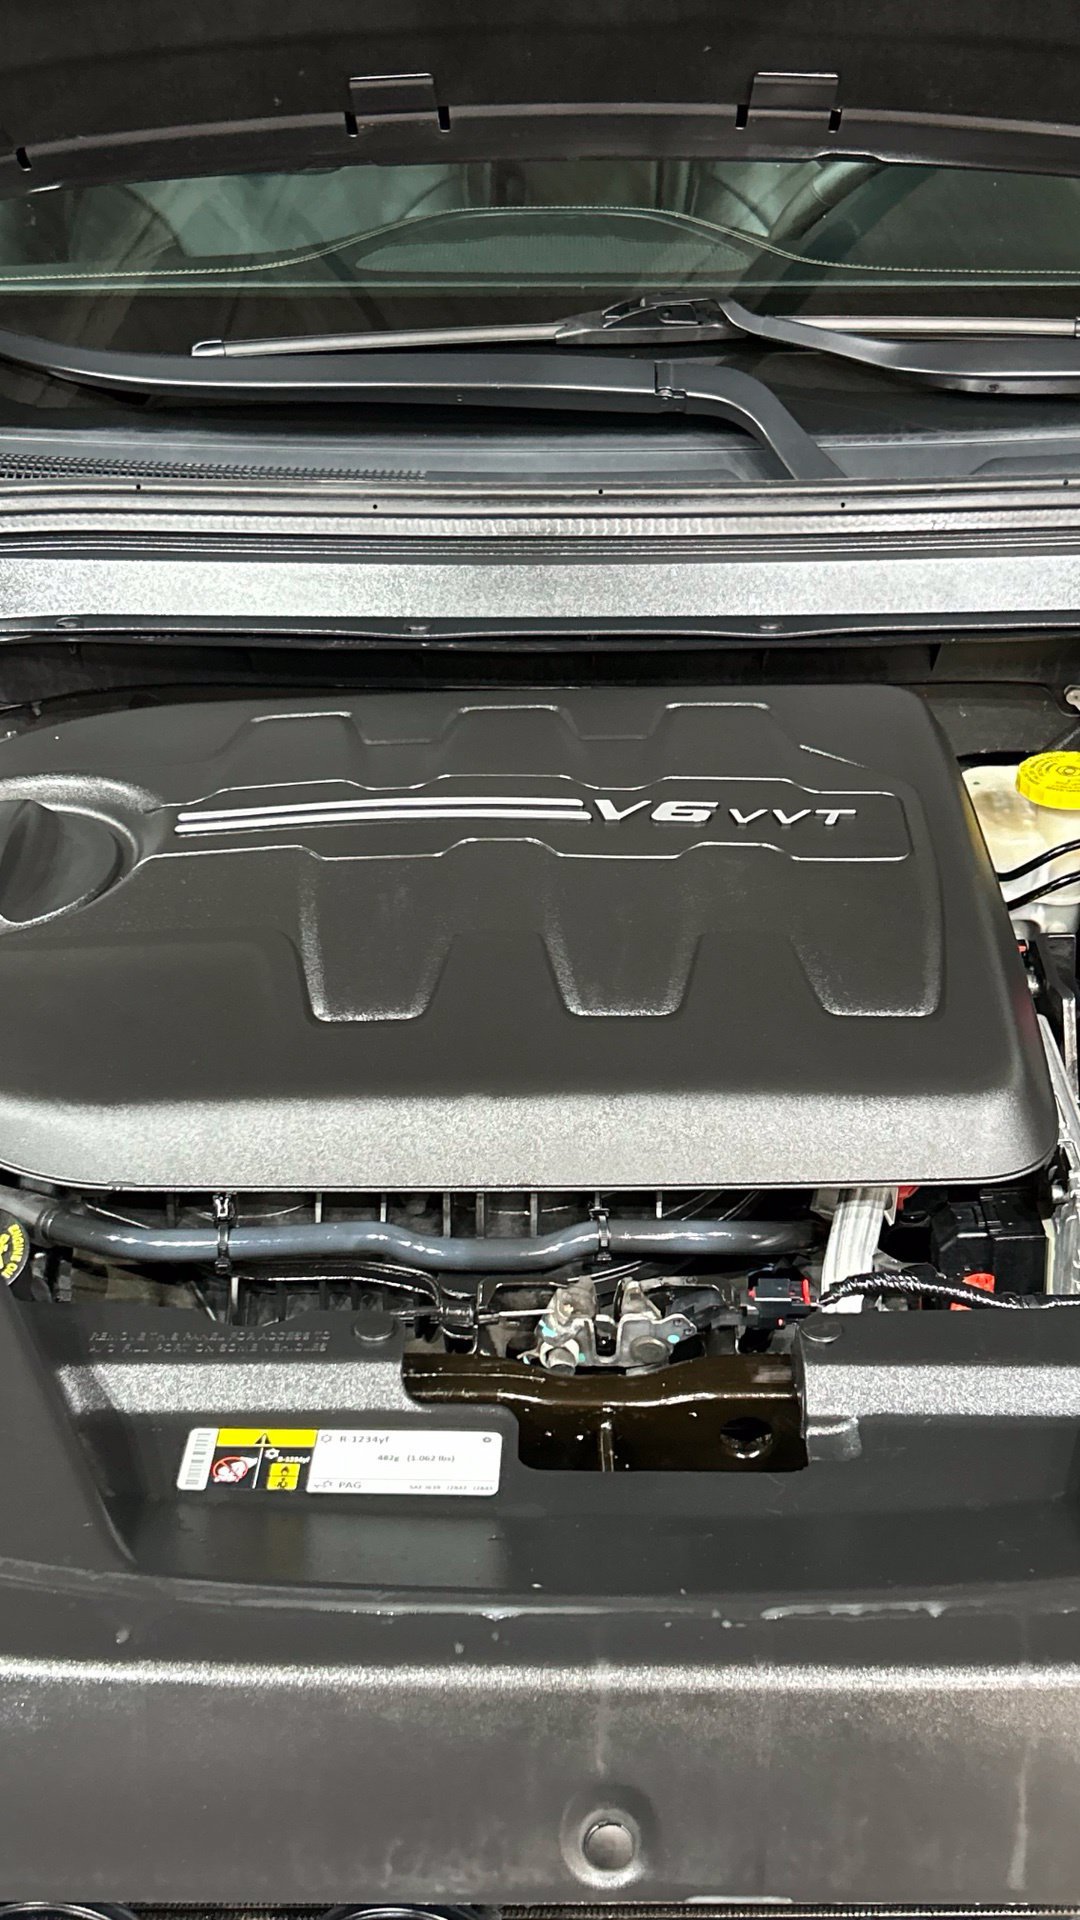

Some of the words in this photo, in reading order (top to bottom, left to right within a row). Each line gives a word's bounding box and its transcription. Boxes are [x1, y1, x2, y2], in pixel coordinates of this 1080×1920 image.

[594, 799, 719, 822] V6
[729, 808, 857, 825] VVT
[7, 1223, 24, 1262] ENGINE
[338, 1481, 362, 1489] PAG
